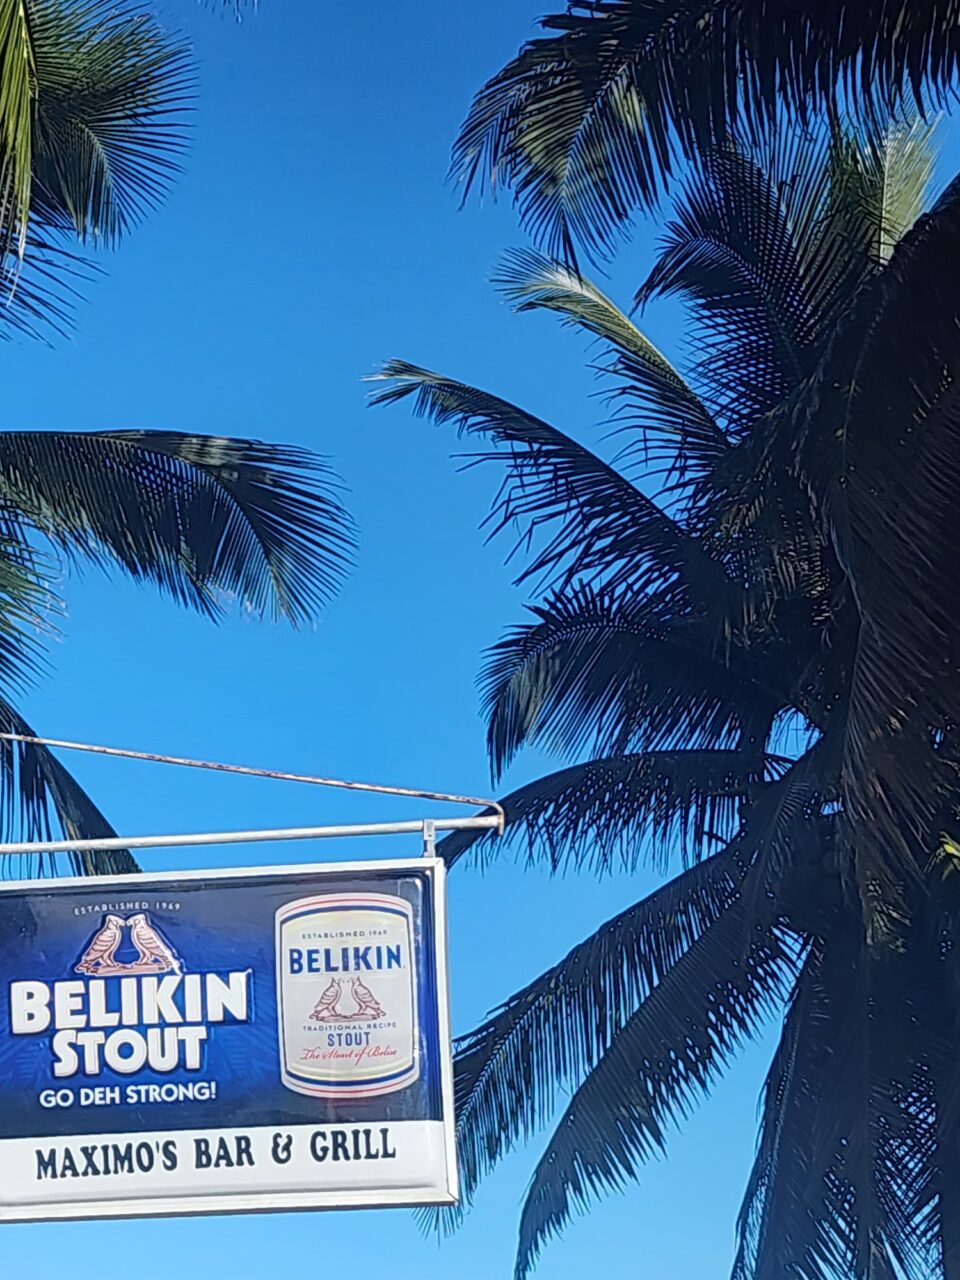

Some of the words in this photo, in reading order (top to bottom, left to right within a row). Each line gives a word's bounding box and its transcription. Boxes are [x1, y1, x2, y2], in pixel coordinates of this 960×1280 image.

[73, 902, 149, 916] ESTABLISHED
[155, 902, 181, 911] 1969
[301, 930, 366, 940] ESTABLISHED
[288, 944, 402, 975] BELIKIN
[10, 972, 248, 1034] BELIKIN
[302, 1024, 363, 1032] TRADITIONAL
[327, 1032, 371, 1047] STOUT
[52, 1026, 208, 1078] STOUT
[300, 1047, 321, 1060] The
[354, 1045, 368, 1067] of
[40, 1089, 74, 1108] GO
[80, 1086, 120, 1106] DEH
[126, 1082, 216, 1104] STRONG!
[35, 1140, 178, 1180] MAXIMO'S
[193, 1135, 256, 1170] BAR
[271, 1132, 293, 1165] &
[309, 1127, 397, 1162] GRILL
